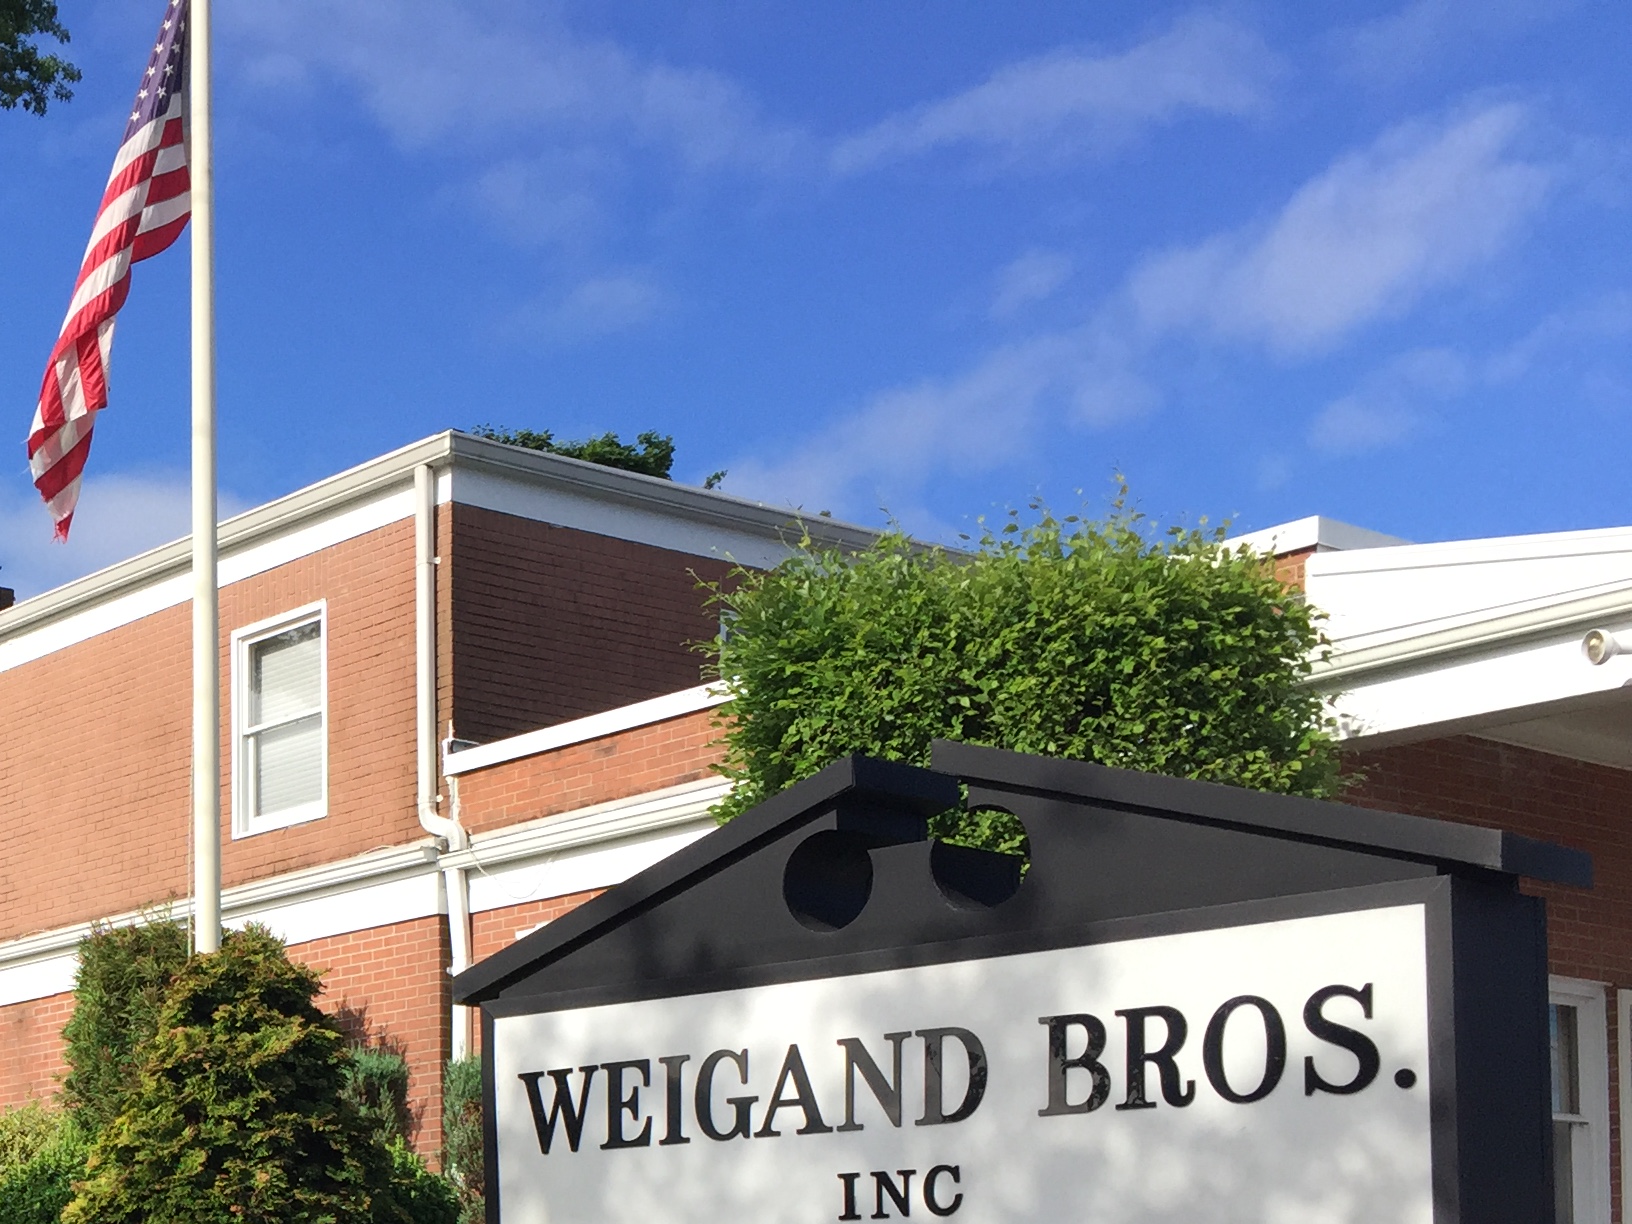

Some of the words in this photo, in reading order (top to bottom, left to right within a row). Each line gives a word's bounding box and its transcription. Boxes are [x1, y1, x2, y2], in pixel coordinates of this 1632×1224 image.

[517, 1025, 989, 1156] WEIGAND
[1037, 982, 1418, 1117] BROS.
[837, 1164, 965, 1222] INC
